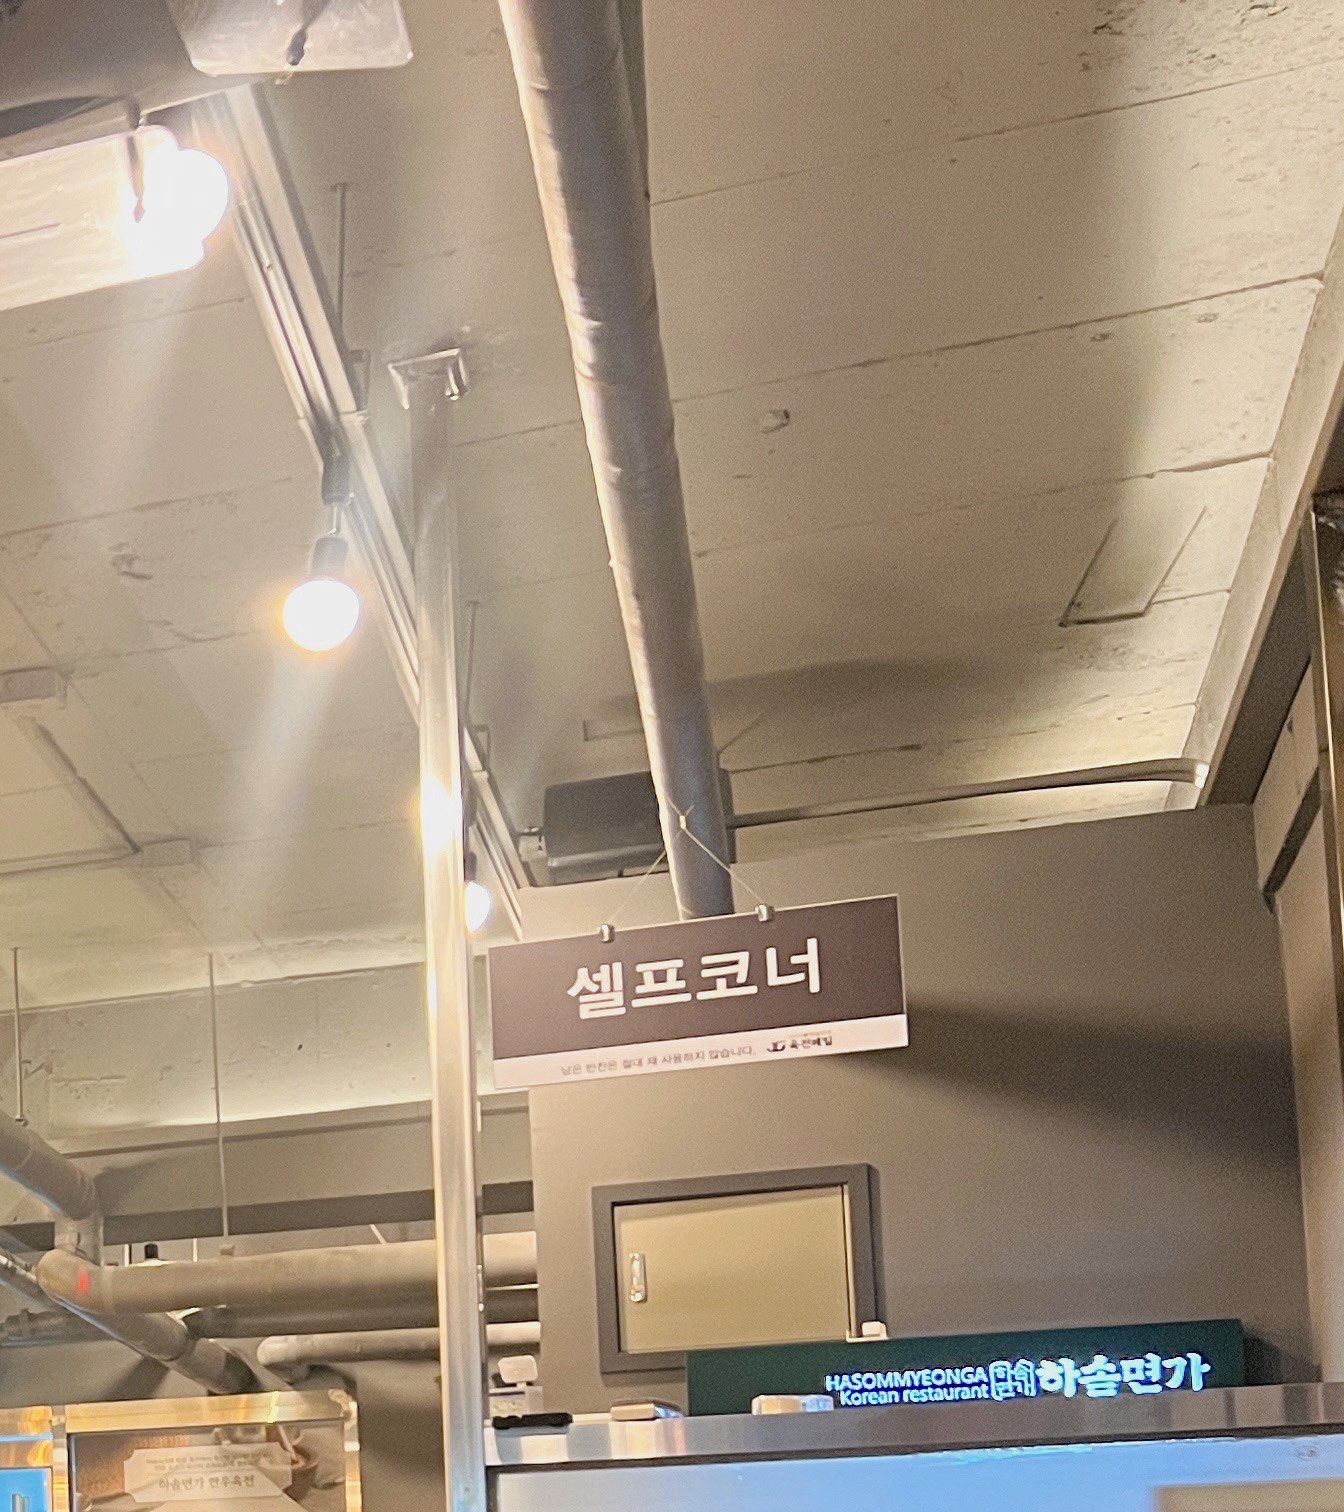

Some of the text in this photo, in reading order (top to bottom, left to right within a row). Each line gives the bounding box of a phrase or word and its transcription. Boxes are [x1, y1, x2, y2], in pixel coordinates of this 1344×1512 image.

[567, 937, 821, 1020] 셀프코너
[825, 1366, 988, 1392] HASOMMYEONGA
[1035, 1351, 1212, 1399] 하솜면가
[840, 1382, 990, 1406] Korean restaurant
